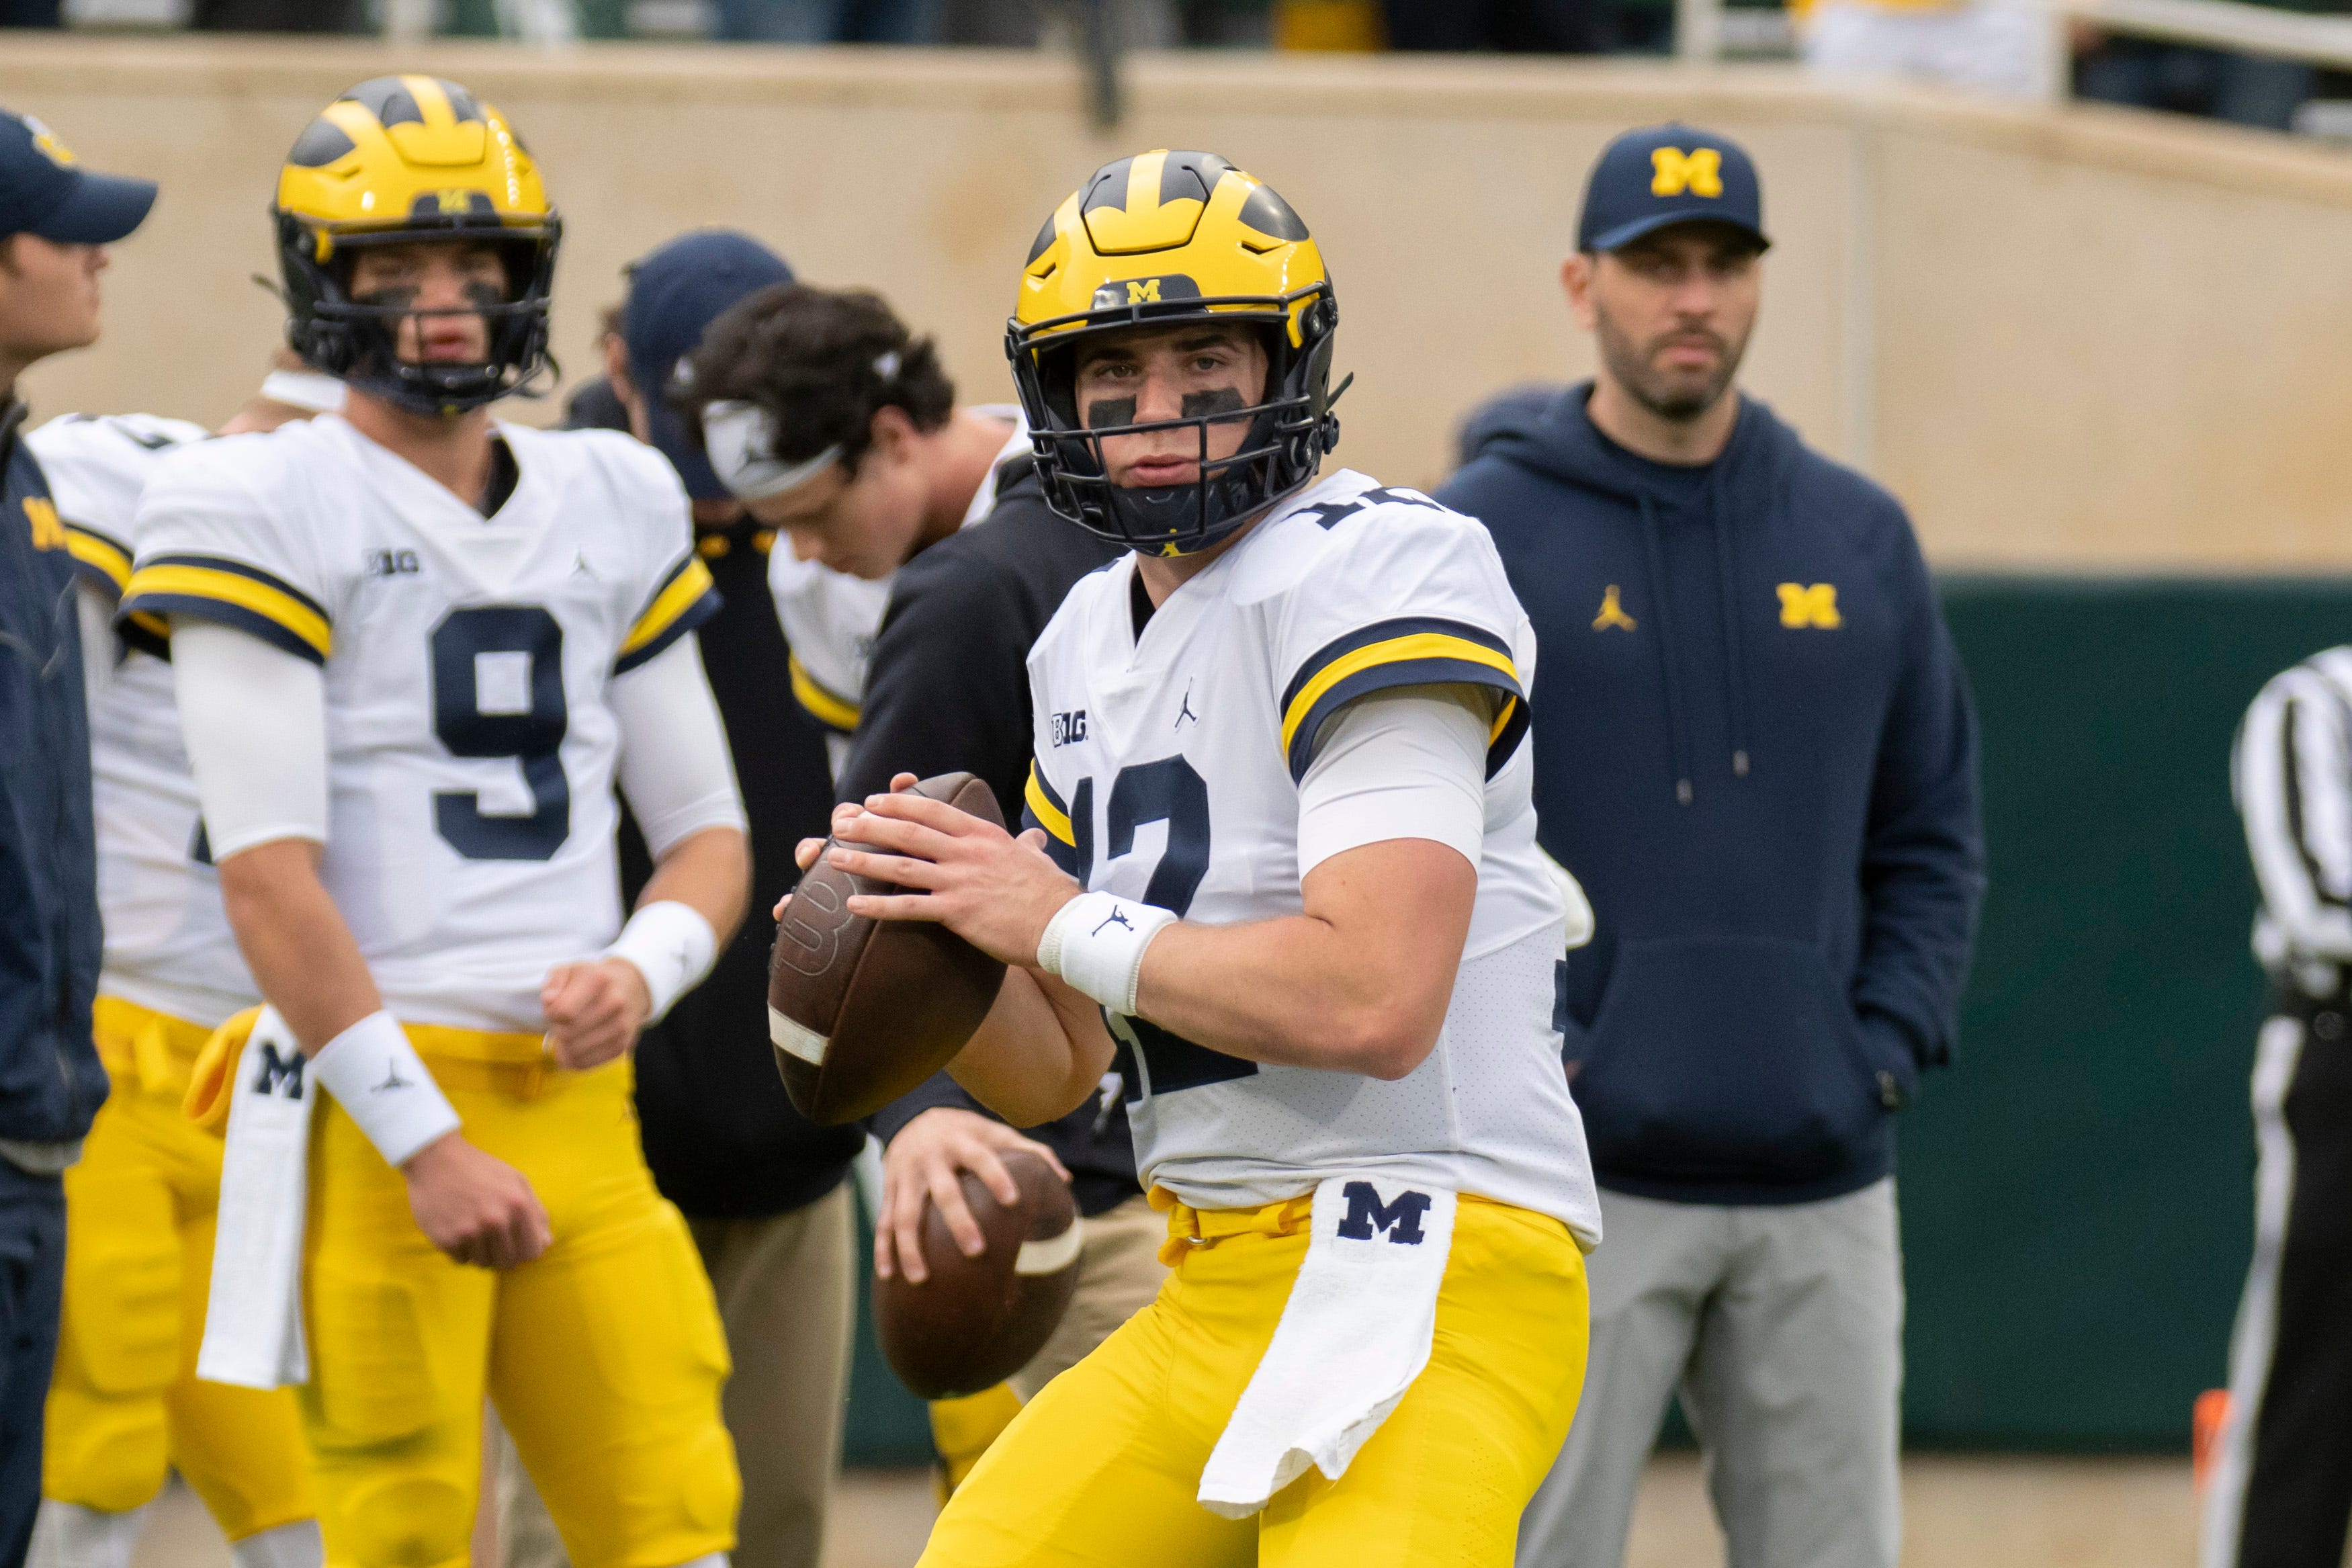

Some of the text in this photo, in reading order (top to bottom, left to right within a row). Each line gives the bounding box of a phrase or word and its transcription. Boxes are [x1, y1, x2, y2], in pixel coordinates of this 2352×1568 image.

[1651, 146, 1724, 199] M
[1126, 279, 1162, 306] M
[1775, 582, 1841, 630] M
[429, 605, 570, 861] 9
[1070, 753, 1259, 1103] 12
[251, 1039, 307, 1100] M
[1336, 1181, 1432, 1245] M
